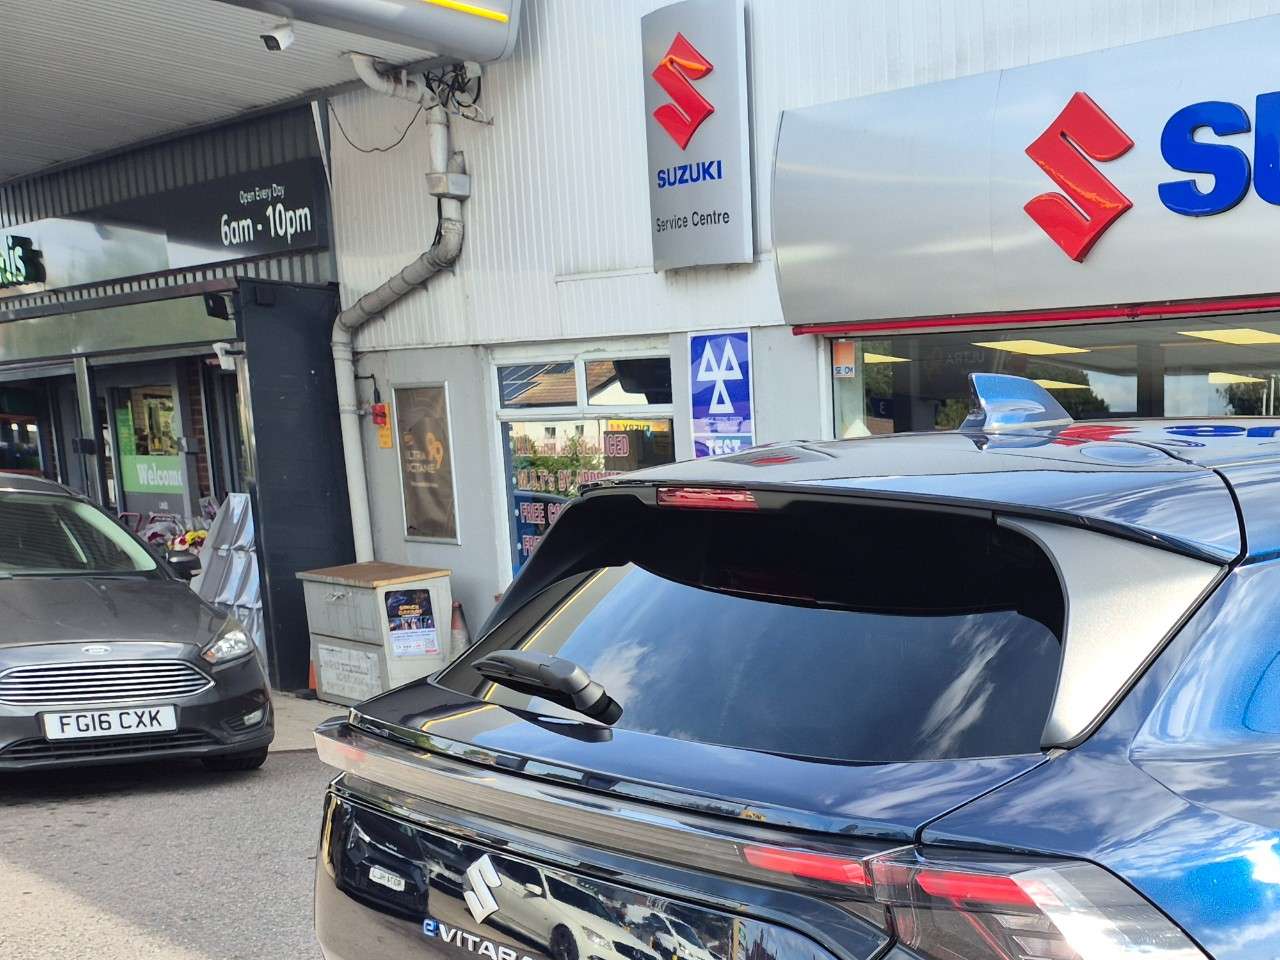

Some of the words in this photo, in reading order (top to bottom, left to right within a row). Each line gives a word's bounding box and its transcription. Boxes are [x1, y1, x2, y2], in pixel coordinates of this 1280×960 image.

[657, 160, 722, 188] SUZUKI
[240, 190, 255, 205] Open
[255, 187, 272, 201] Every
[272, 183, 285, 199] Day
[221, 214, 254, 246] 6am
[266, 203, 312, 244] 10pm
[656, 214, 688, 232] Service
[691, 210, 730, 226] Centre
[520, 502, 546, 524] FREE
[59, 713, 112, 734] FG16
[119, 709, 163, 730] CXK
